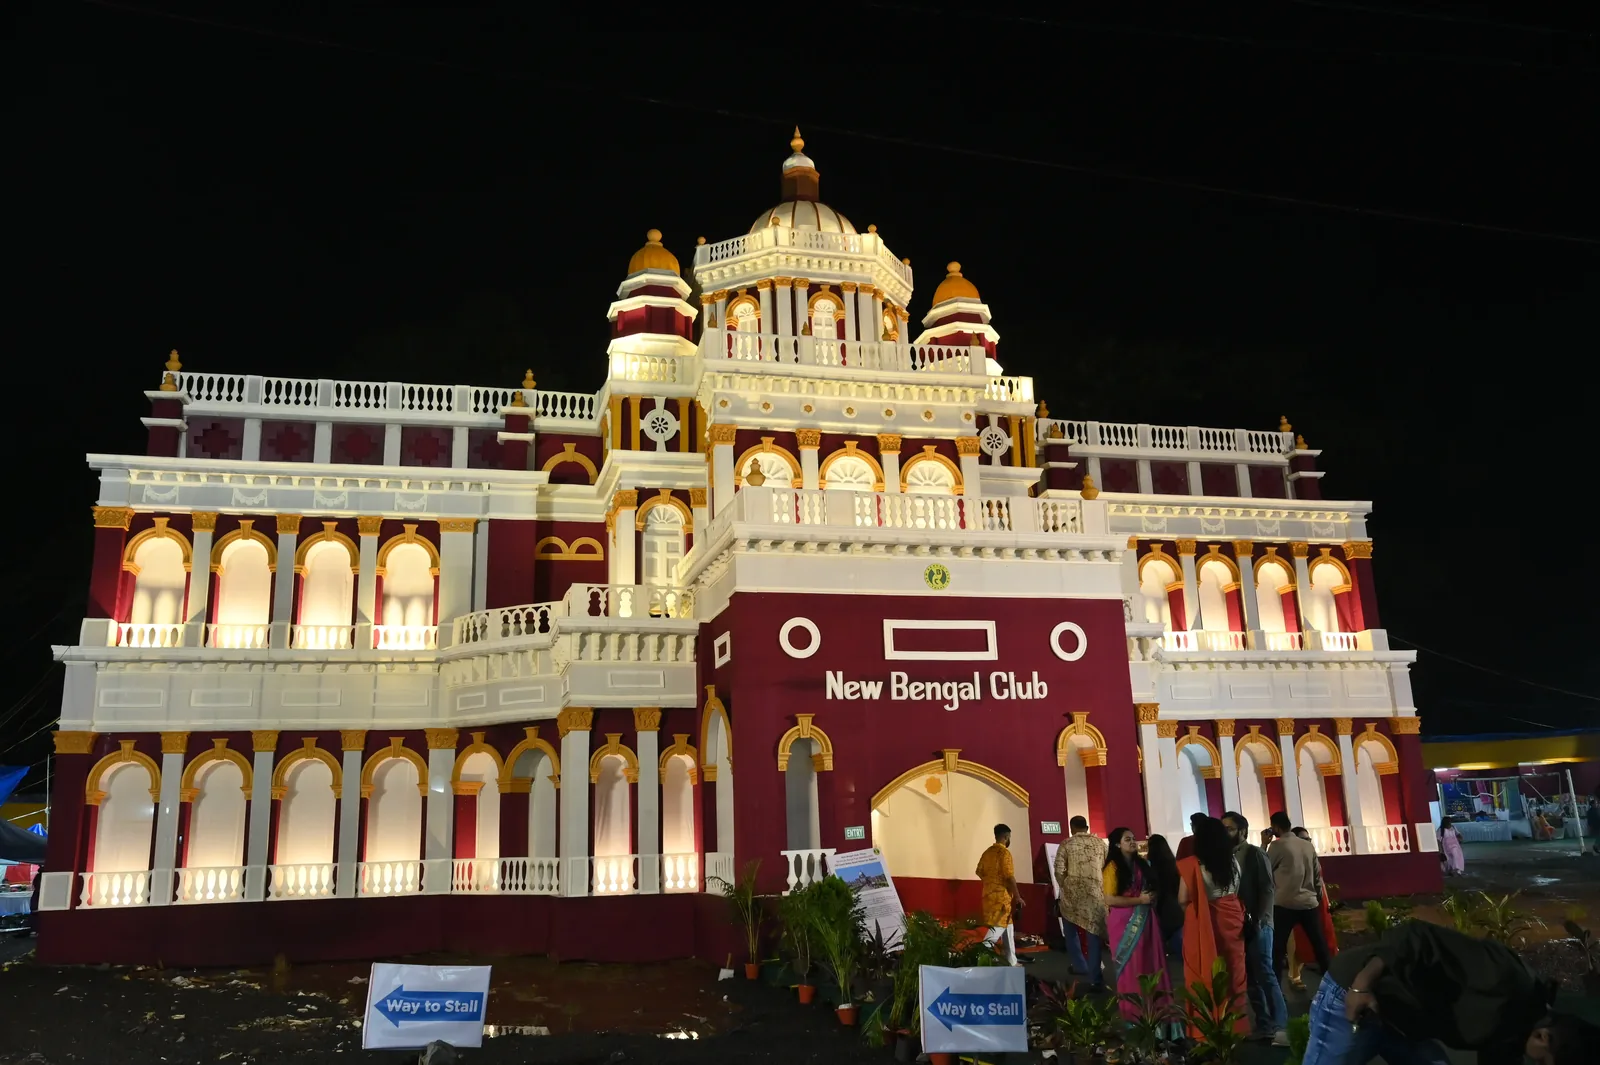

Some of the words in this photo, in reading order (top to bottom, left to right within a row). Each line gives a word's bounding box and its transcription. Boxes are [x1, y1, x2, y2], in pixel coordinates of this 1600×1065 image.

[825, 670, 883, 700] New
[890, 671, 981, 711] Bengal
[989, 671, 1048, 699] Club
[846, 828, 864, 838] ENTRY
[1043, 823, 1059, 832] ENTRY
[386, 999, 420, 1014] Way
[424, 1000, 441, 1012] to
[444, 1000, 478, 1012] Stall
[937, 1002, 967, 1017] Way
[970, 1003, 985, 1015] to
[988, 1002, 1019, 1015] Stall
